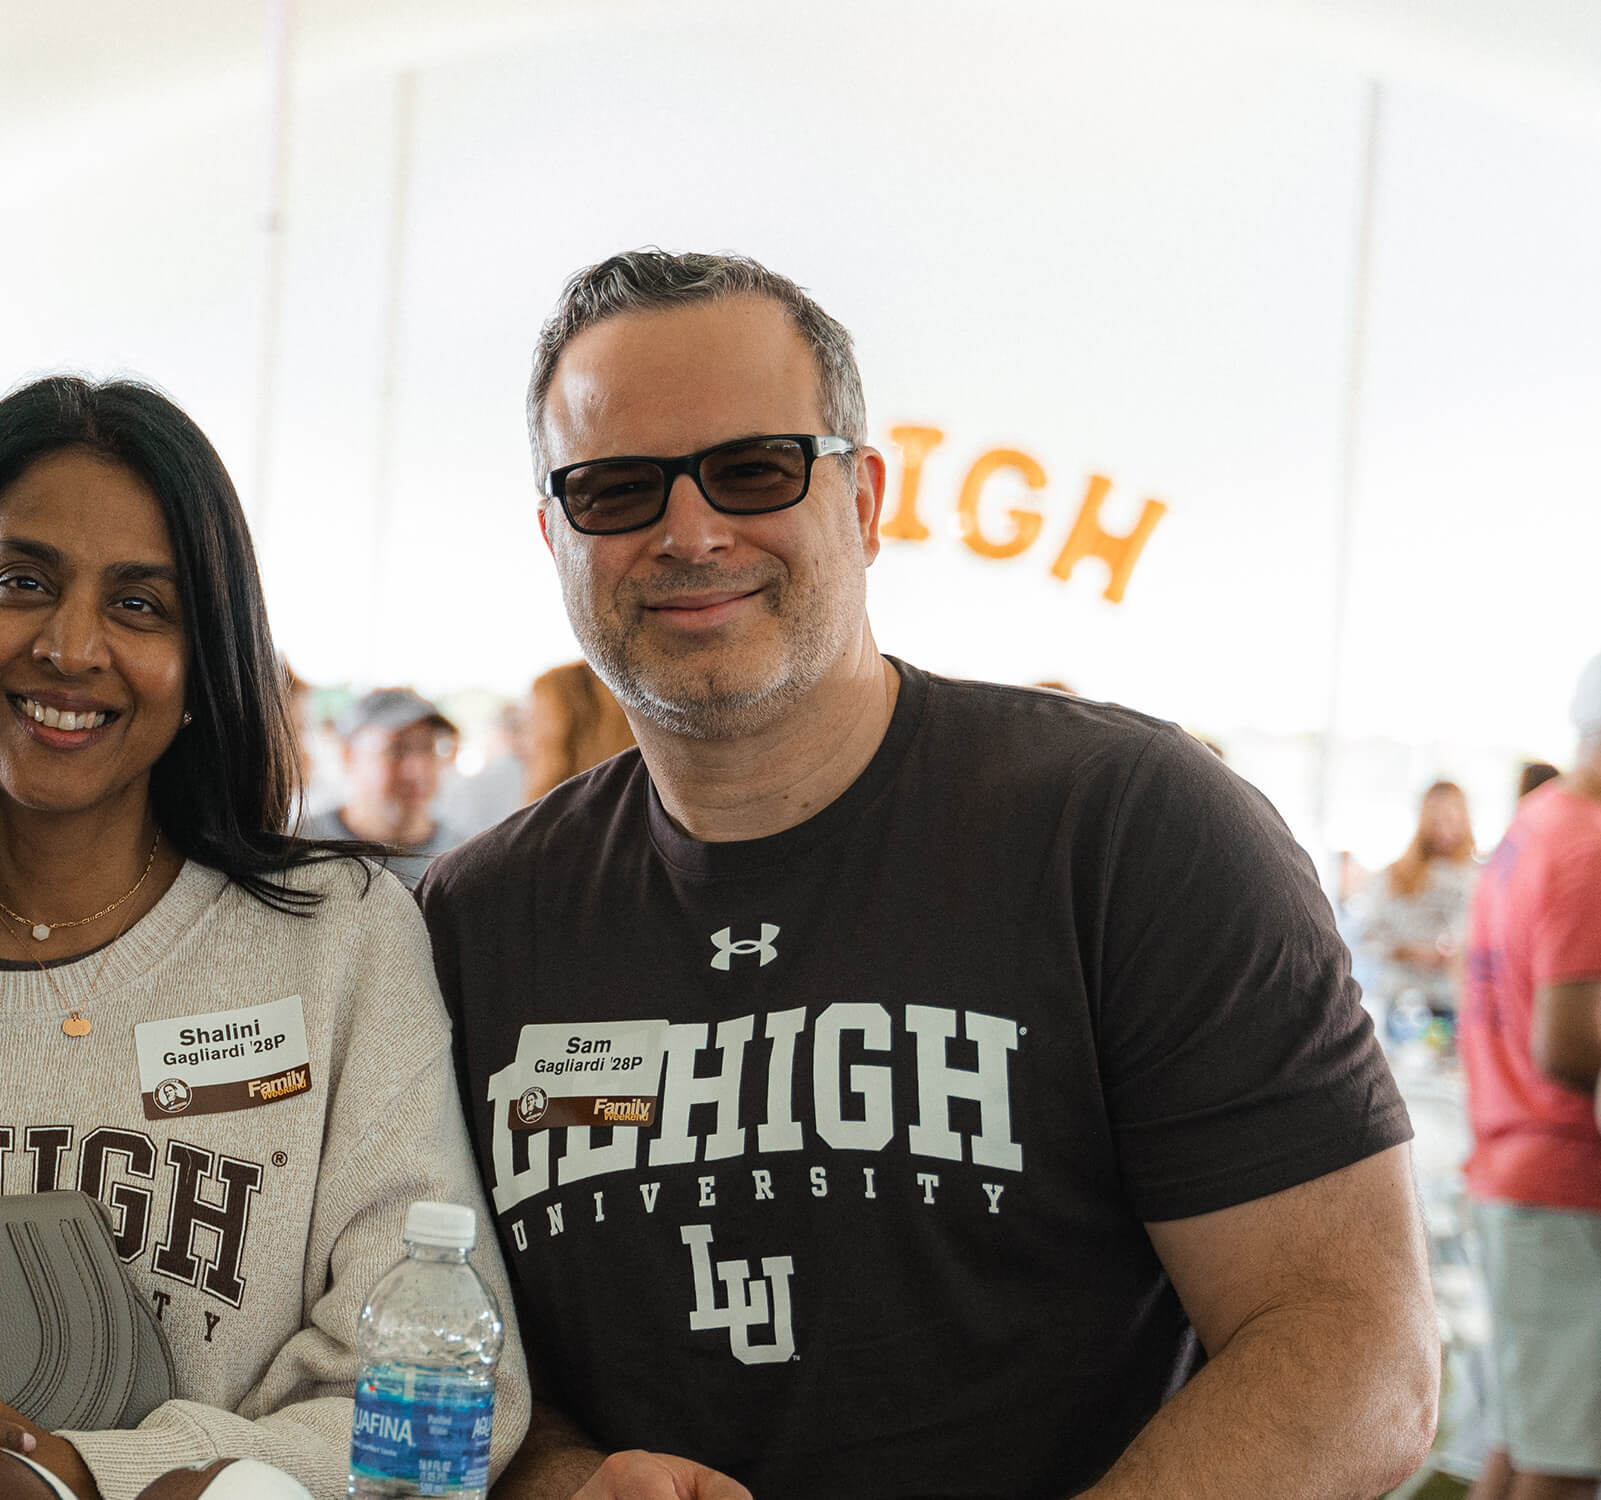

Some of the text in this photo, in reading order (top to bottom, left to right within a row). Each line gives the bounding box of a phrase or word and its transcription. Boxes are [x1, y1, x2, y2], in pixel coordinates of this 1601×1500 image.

[880, 426, 1168, 606] IGH
[179, 1019, 261, 1046] Shalini
[565, 1036, 612, 1054] Sam
[163, 1034, 286, 1066] Gagliardi '28P
[534, 1056, 643, 1075] Gagliardi '28P
[248, 1069, 306, 1097] Family
[593, 1098, 651, 1117] Family
[512, 1166, 1004, 1252] UNIVERSITY
[680, 1224, 795, 1365] LU
[354, 1408, 413, 1448] UAFINA
